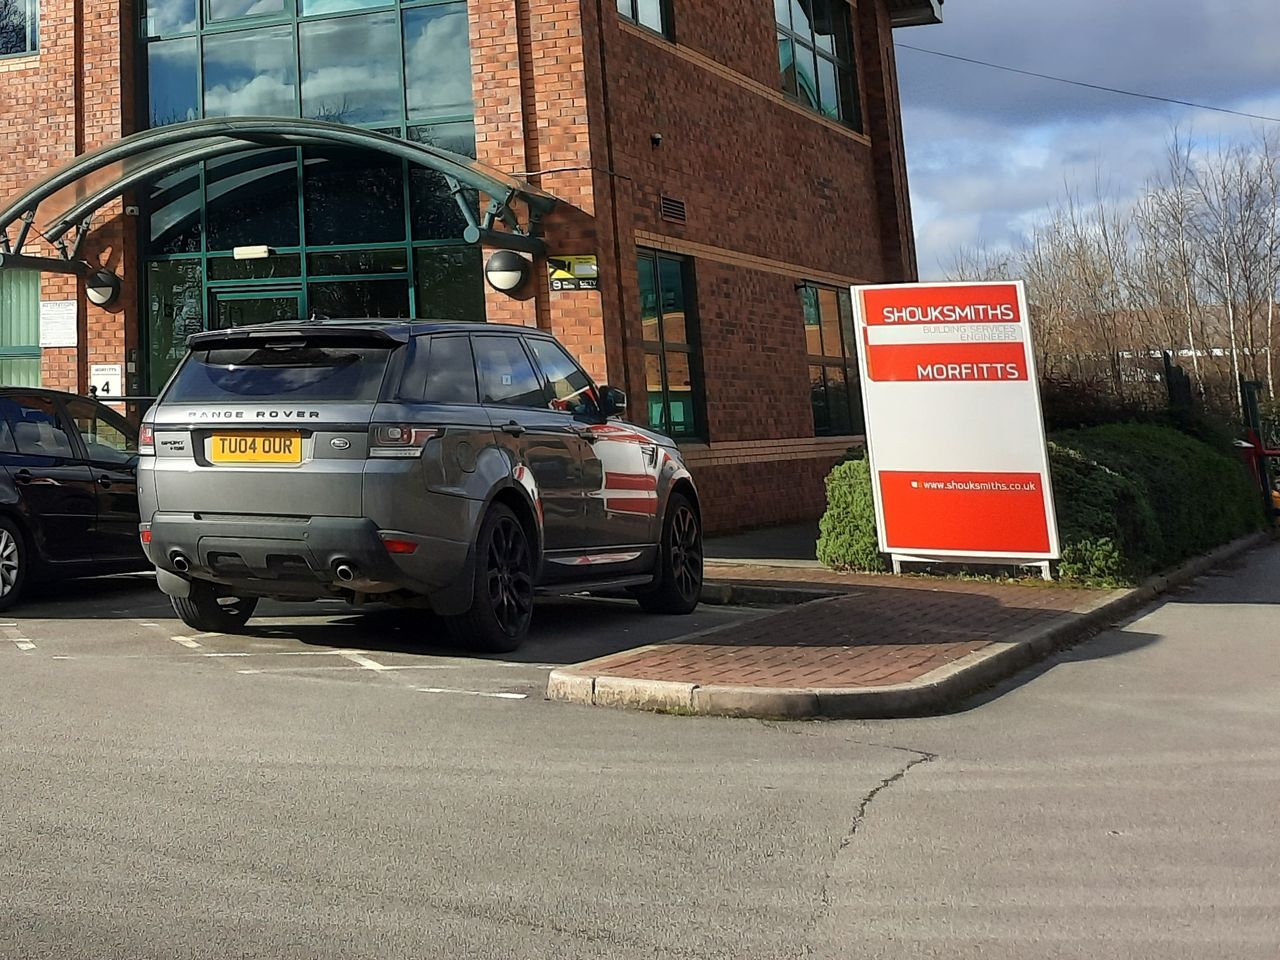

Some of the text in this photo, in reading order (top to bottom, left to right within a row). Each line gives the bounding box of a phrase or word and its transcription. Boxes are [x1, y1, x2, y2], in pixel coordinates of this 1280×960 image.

[883, 304, 1013, 323] SHOUKSMITHS
[923, 324, 1016, 334] BUILDING SERVICES
[960, 332, 1017, 341] ENGINEERS
[917, 363, 1018, 379] MORFITTS
[101, 381, 110, 394] 4
[256, 410, 320, 418] ROVER
[220, 438, 257, 454] TU04
[923, 481, 1036, 490] www.shouksmiths.co.uk
